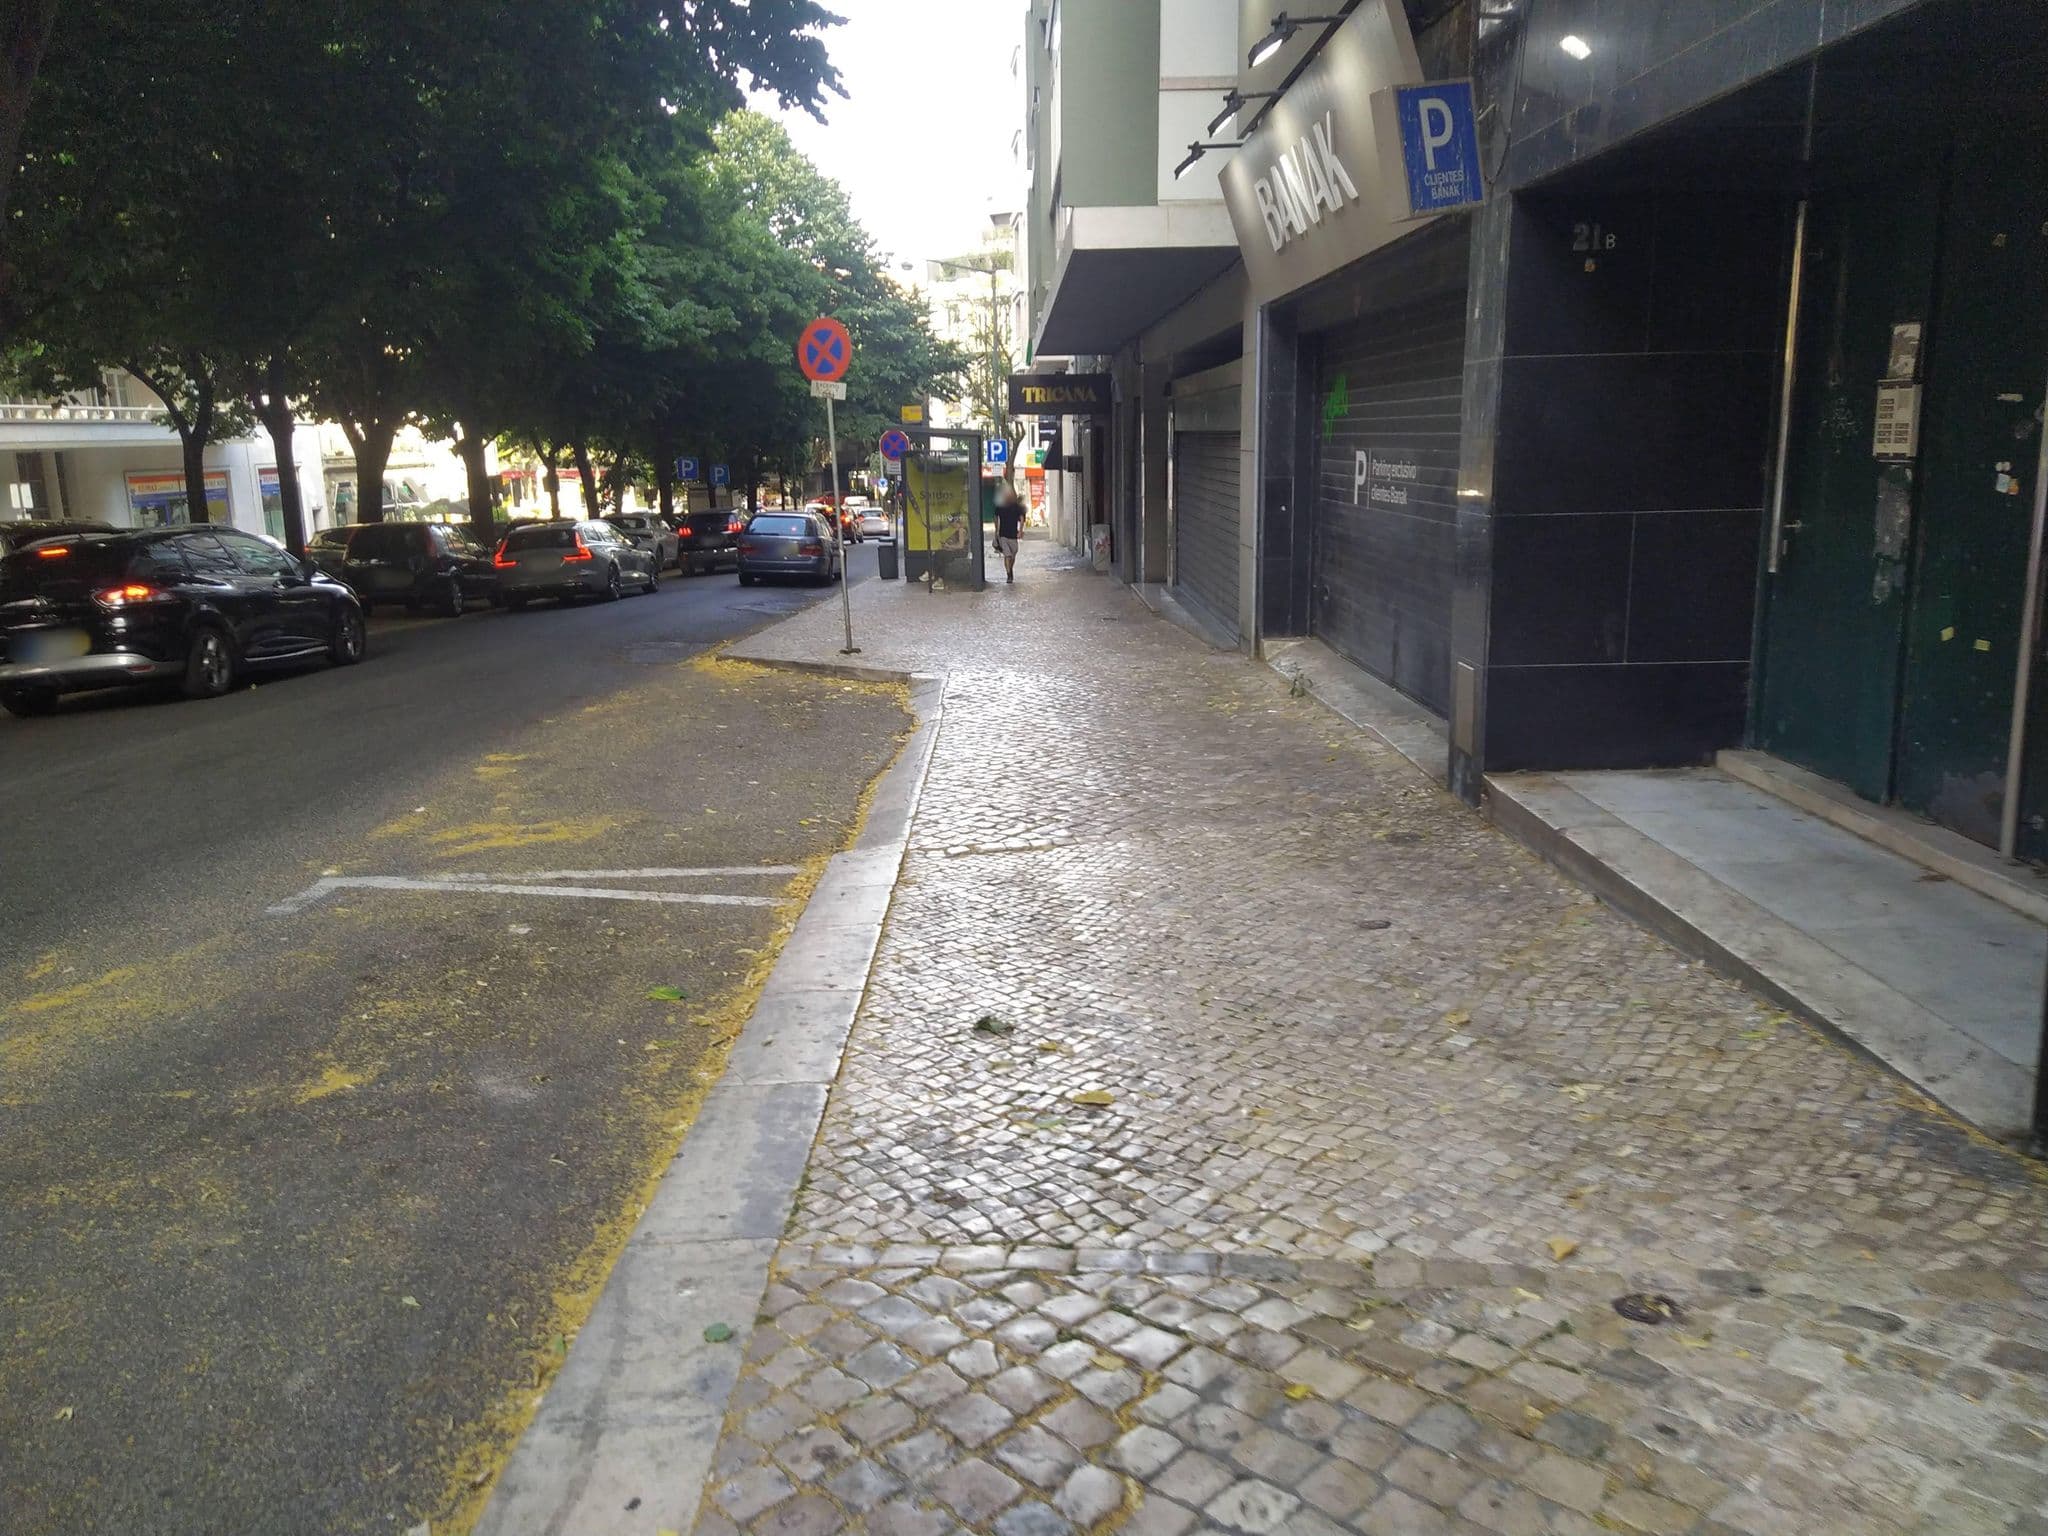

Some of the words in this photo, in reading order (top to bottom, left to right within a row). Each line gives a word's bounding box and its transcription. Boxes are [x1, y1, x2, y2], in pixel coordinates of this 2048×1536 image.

[1419, 98, 1453, 170] P
[1254, 110, 1358, 252] BANAK
[1424, 169, 1464, 186] CLIENTES
[1431, 184, 1460, 200] BANAK
[1021, 386, 1096, 403] TRICANA
[991, 442, 1003, 460] P
[682, 459, 693, 477] P
[714, 467, 725, 481] P
[1372, 459, 1391, 481] Parking
[1354, 450, 1367, 505] P
